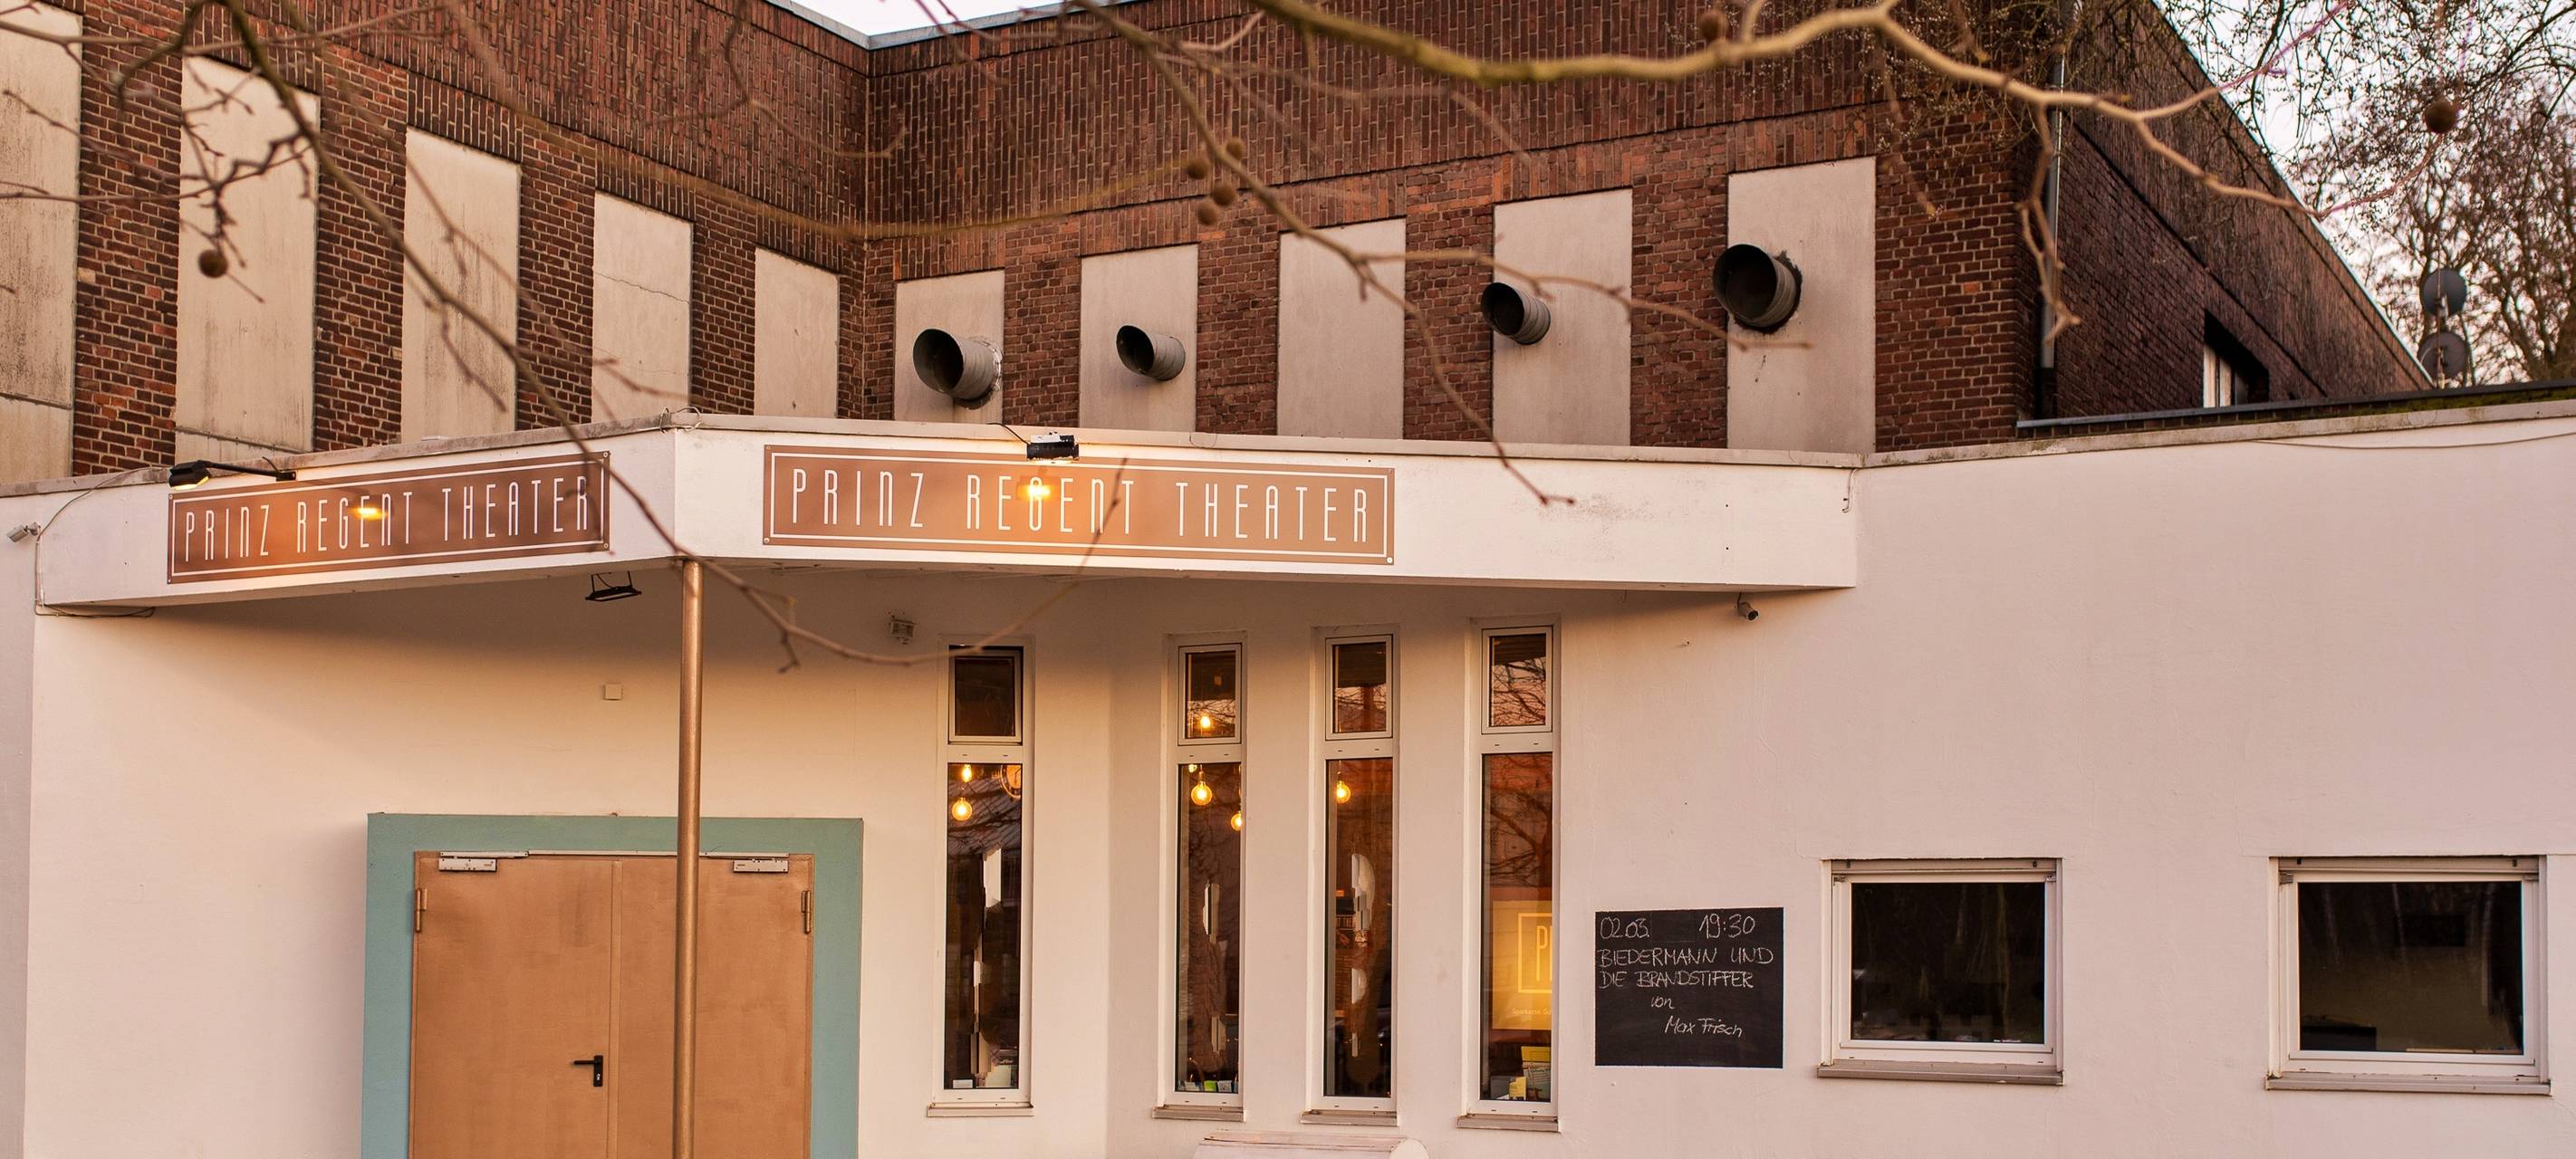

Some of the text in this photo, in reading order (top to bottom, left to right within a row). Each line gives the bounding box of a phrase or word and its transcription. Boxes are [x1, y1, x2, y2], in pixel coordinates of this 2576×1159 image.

[793, 468, 1368, 542] PRINZ REGENT THEATER
[185, 475, 589, 562] PRINZ REGENT THEATER
[1698, 913, 1755, 939] 19:30
[1598, 947, 1774, 968] BIEDERMANN UND
[1599, 971, 1628, 989] DIE
[1650, 996, 1676, 1010] von
[1664, 1015, 1743, 1039] Max Frisch
